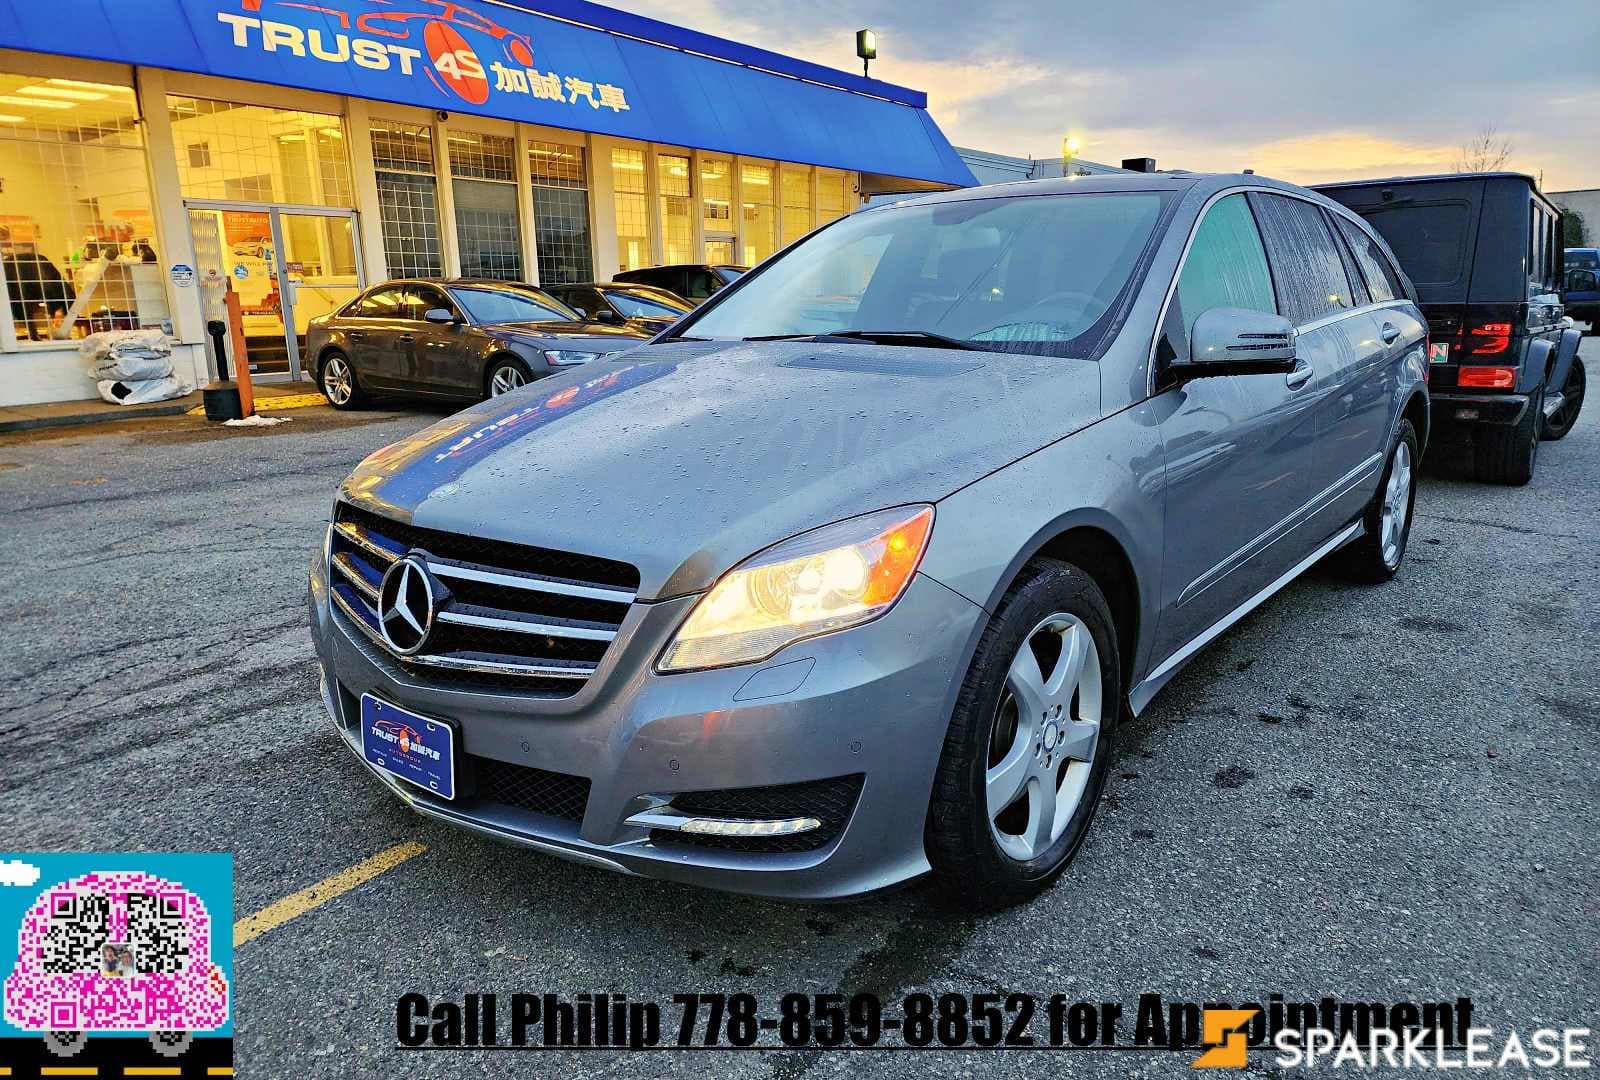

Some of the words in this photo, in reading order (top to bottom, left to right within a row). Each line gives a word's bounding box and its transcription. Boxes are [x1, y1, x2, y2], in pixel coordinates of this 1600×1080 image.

[217, 12, 421, 75] TRUST
[434, 48, 487, 80] 4S
[489, 61, 630, 112] 加誠汽車
[1430, 344, 1446, 359] N
[371, 726, 399, 744] TRUST
